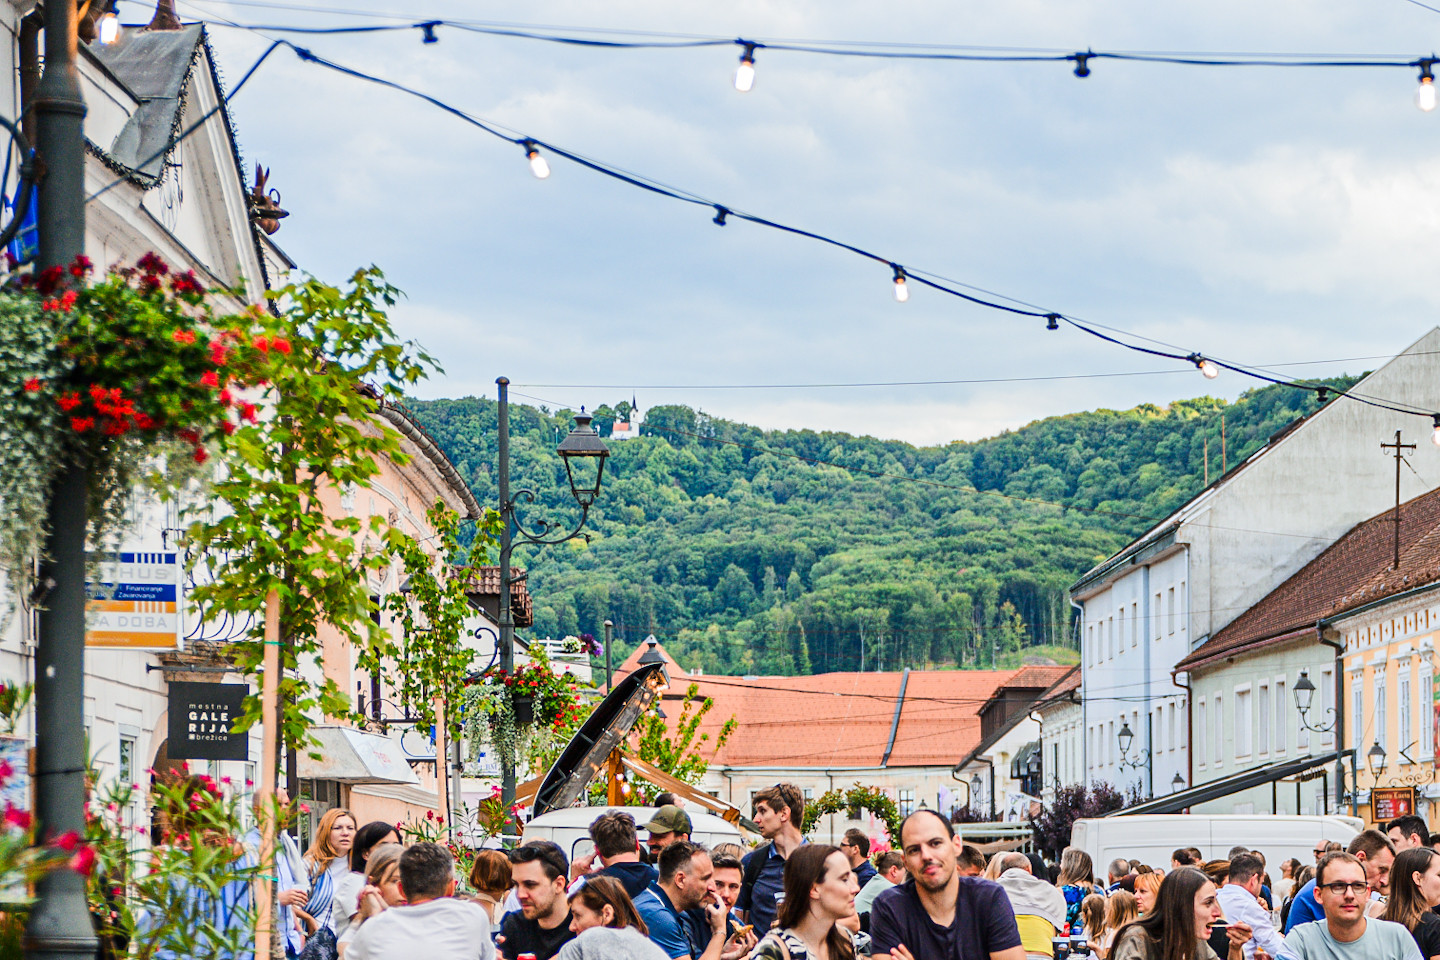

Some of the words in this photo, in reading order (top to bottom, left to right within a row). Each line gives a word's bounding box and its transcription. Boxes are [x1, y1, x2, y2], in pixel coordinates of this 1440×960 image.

[118, 615, 168, 628] DOBA
[188, 703, 229, 711] mestna
[188, 711, 229, 722] GALE
[188, 723, 228, 734] RIJA
